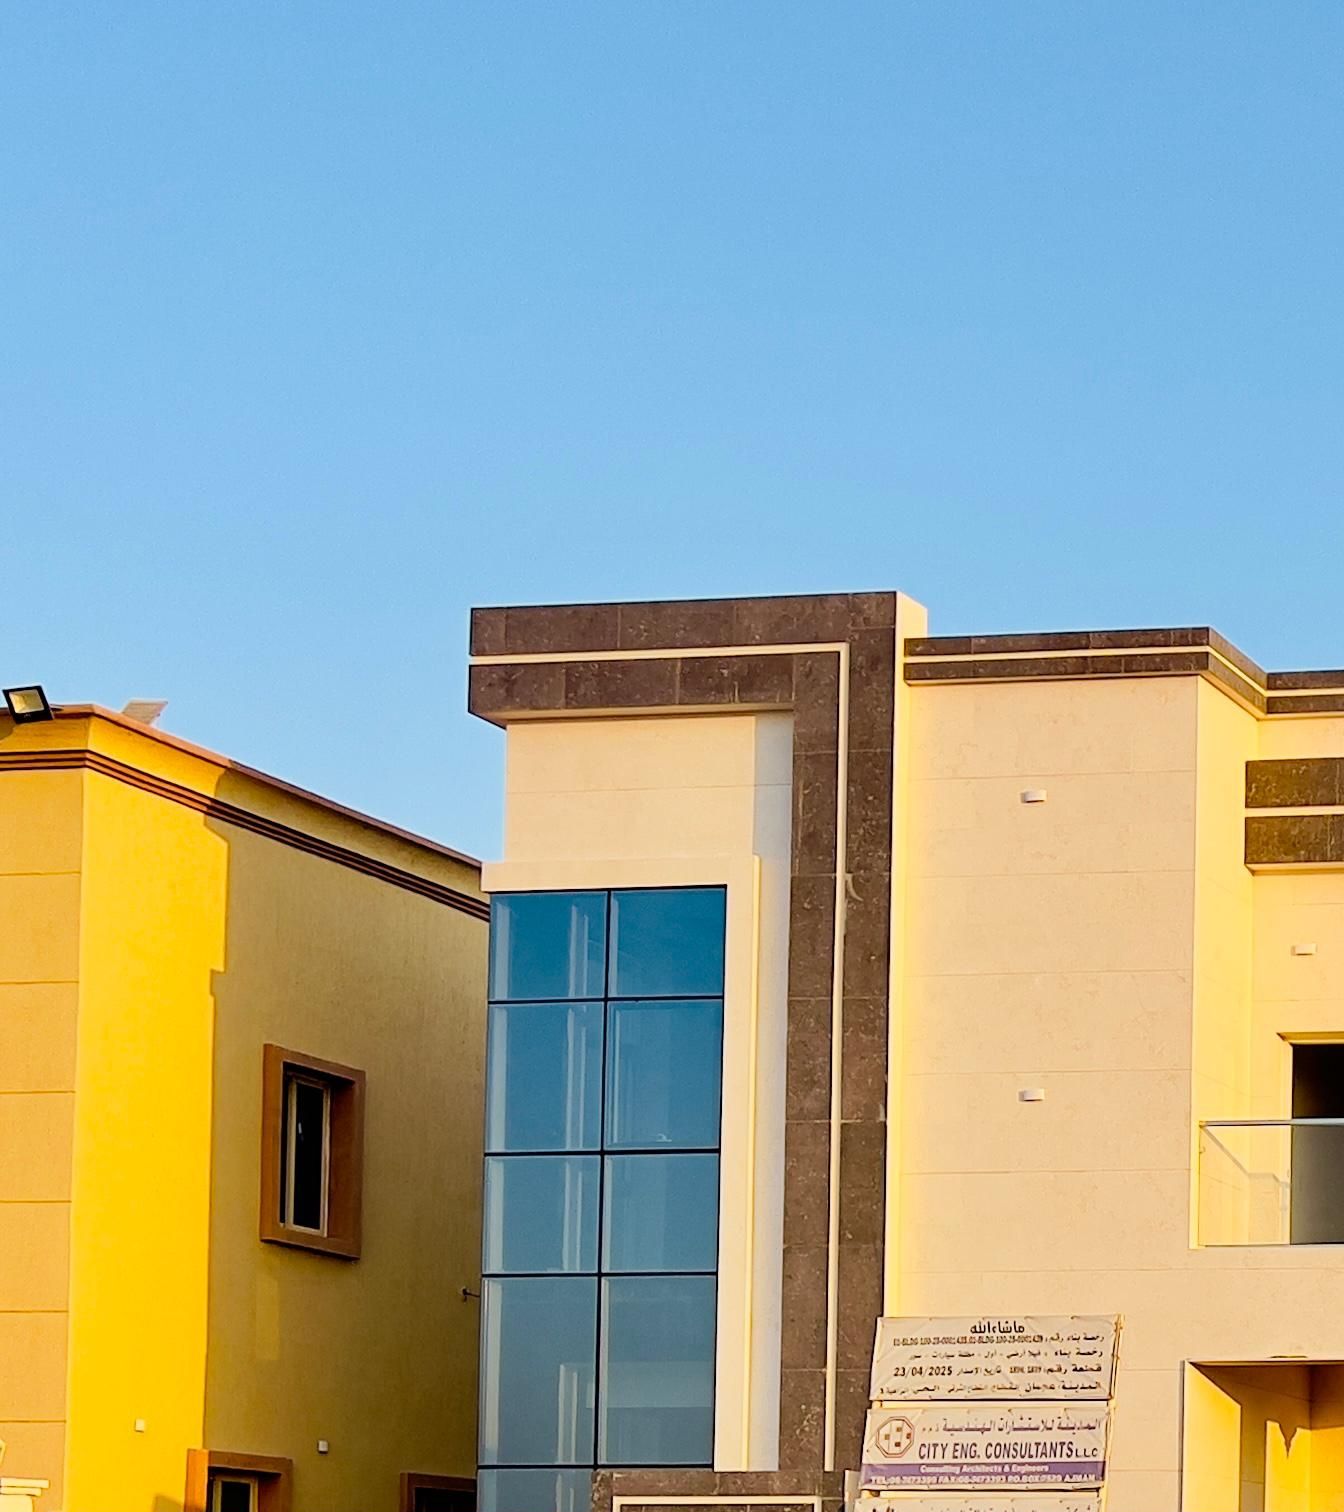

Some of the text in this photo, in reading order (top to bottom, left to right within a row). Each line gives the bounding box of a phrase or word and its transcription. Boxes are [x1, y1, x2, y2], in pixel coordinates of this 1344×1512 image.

[893, 1365, 953, 1378] 23/04/2025
[943, 1417, 993, 1436] الهندسية
[998, 1416, 1054, 1435] للاستشارات
[1057, 1416, 1100, 1435] المدينة
[919, 1442, 948, 1459] CITY
[952, 1442, 981, 1459] ENG.
[985, 1441, 1074, 1459] CONSULTANTS
[1003, 1464, 1010, 1473] &
